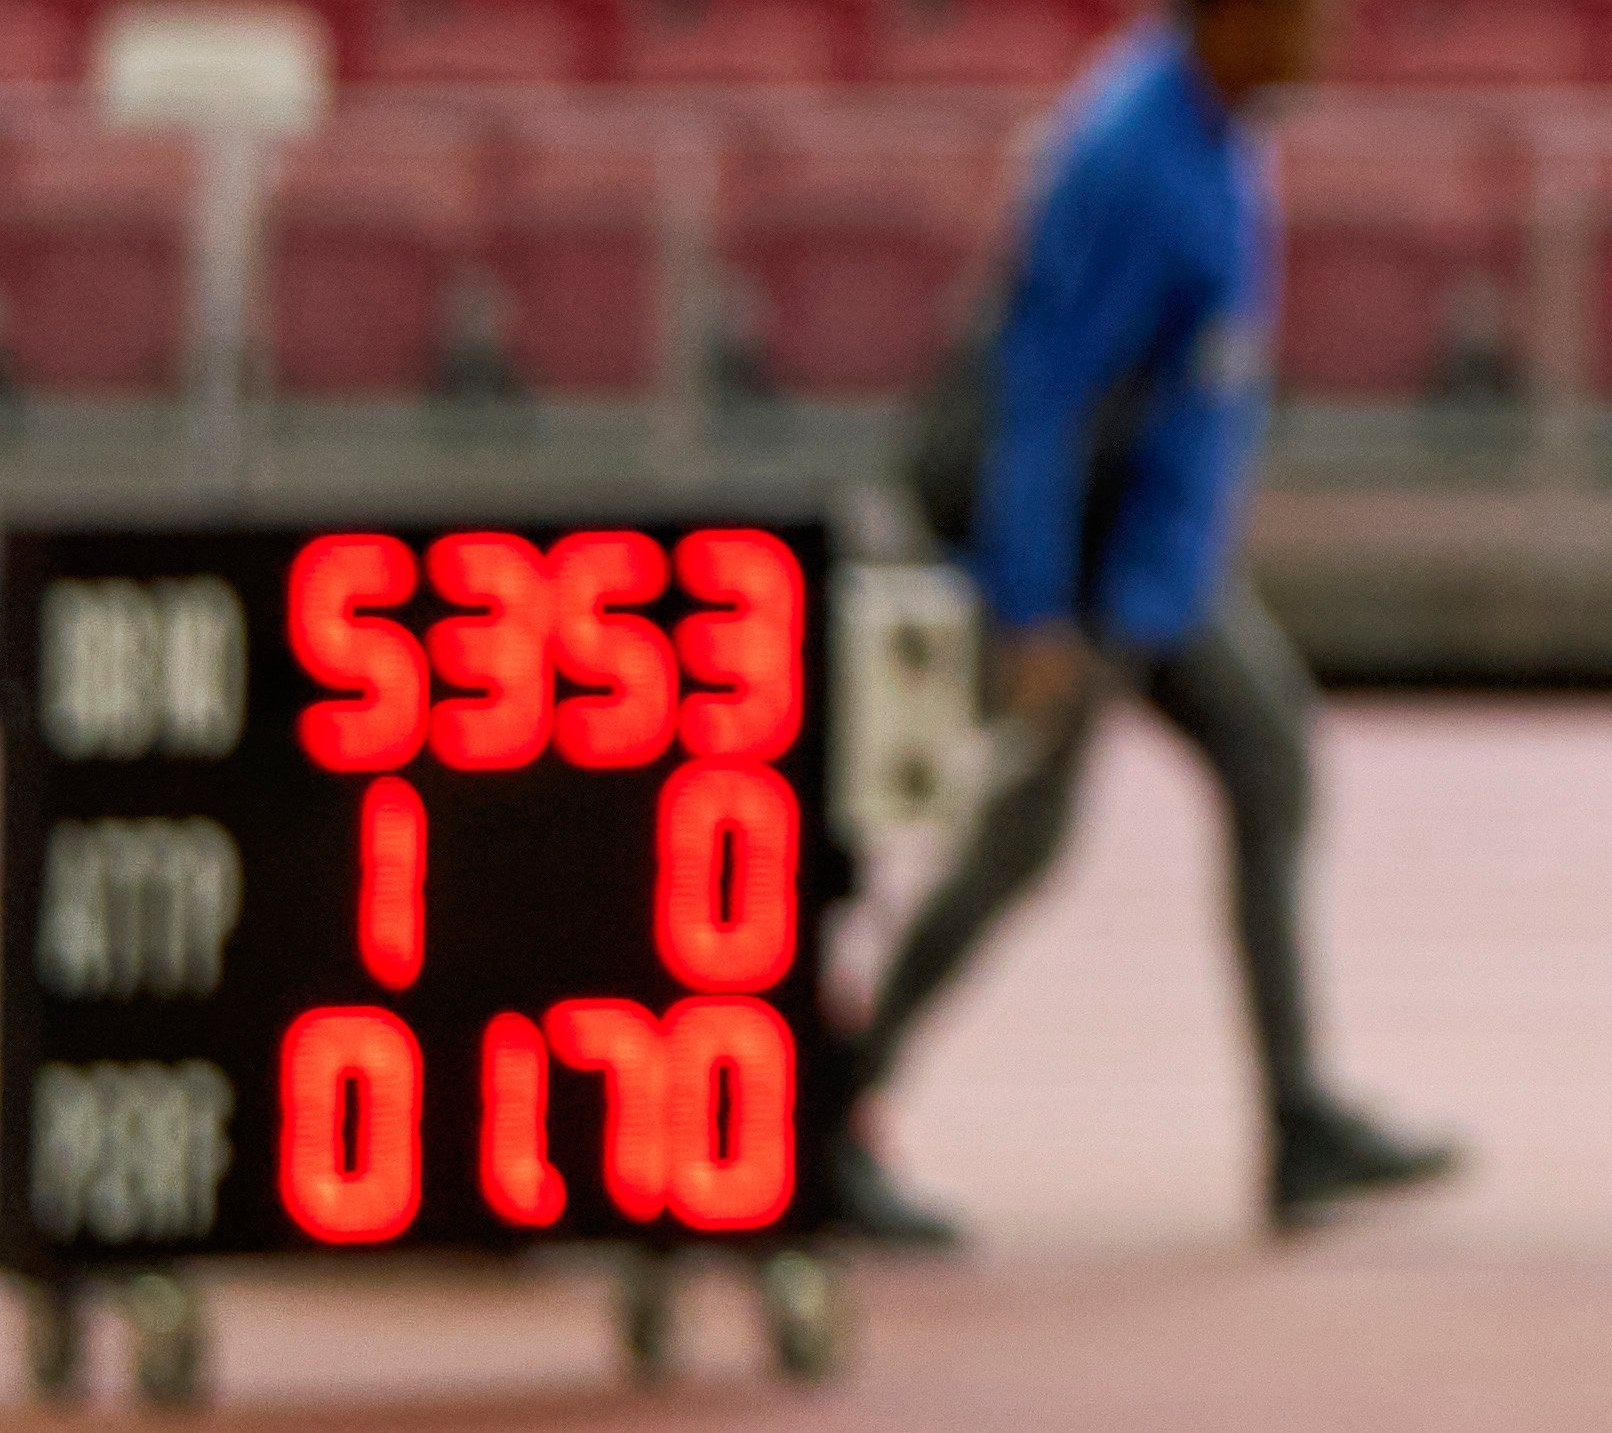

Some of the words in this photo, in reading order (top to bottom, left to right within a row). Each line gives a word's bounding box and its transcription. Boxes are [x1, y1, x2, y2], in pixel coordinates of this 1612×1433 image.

[288, 529, 806, 775] 5353
[359, 775, 428, 992] 1
[655, 757, 800, 995] 0
